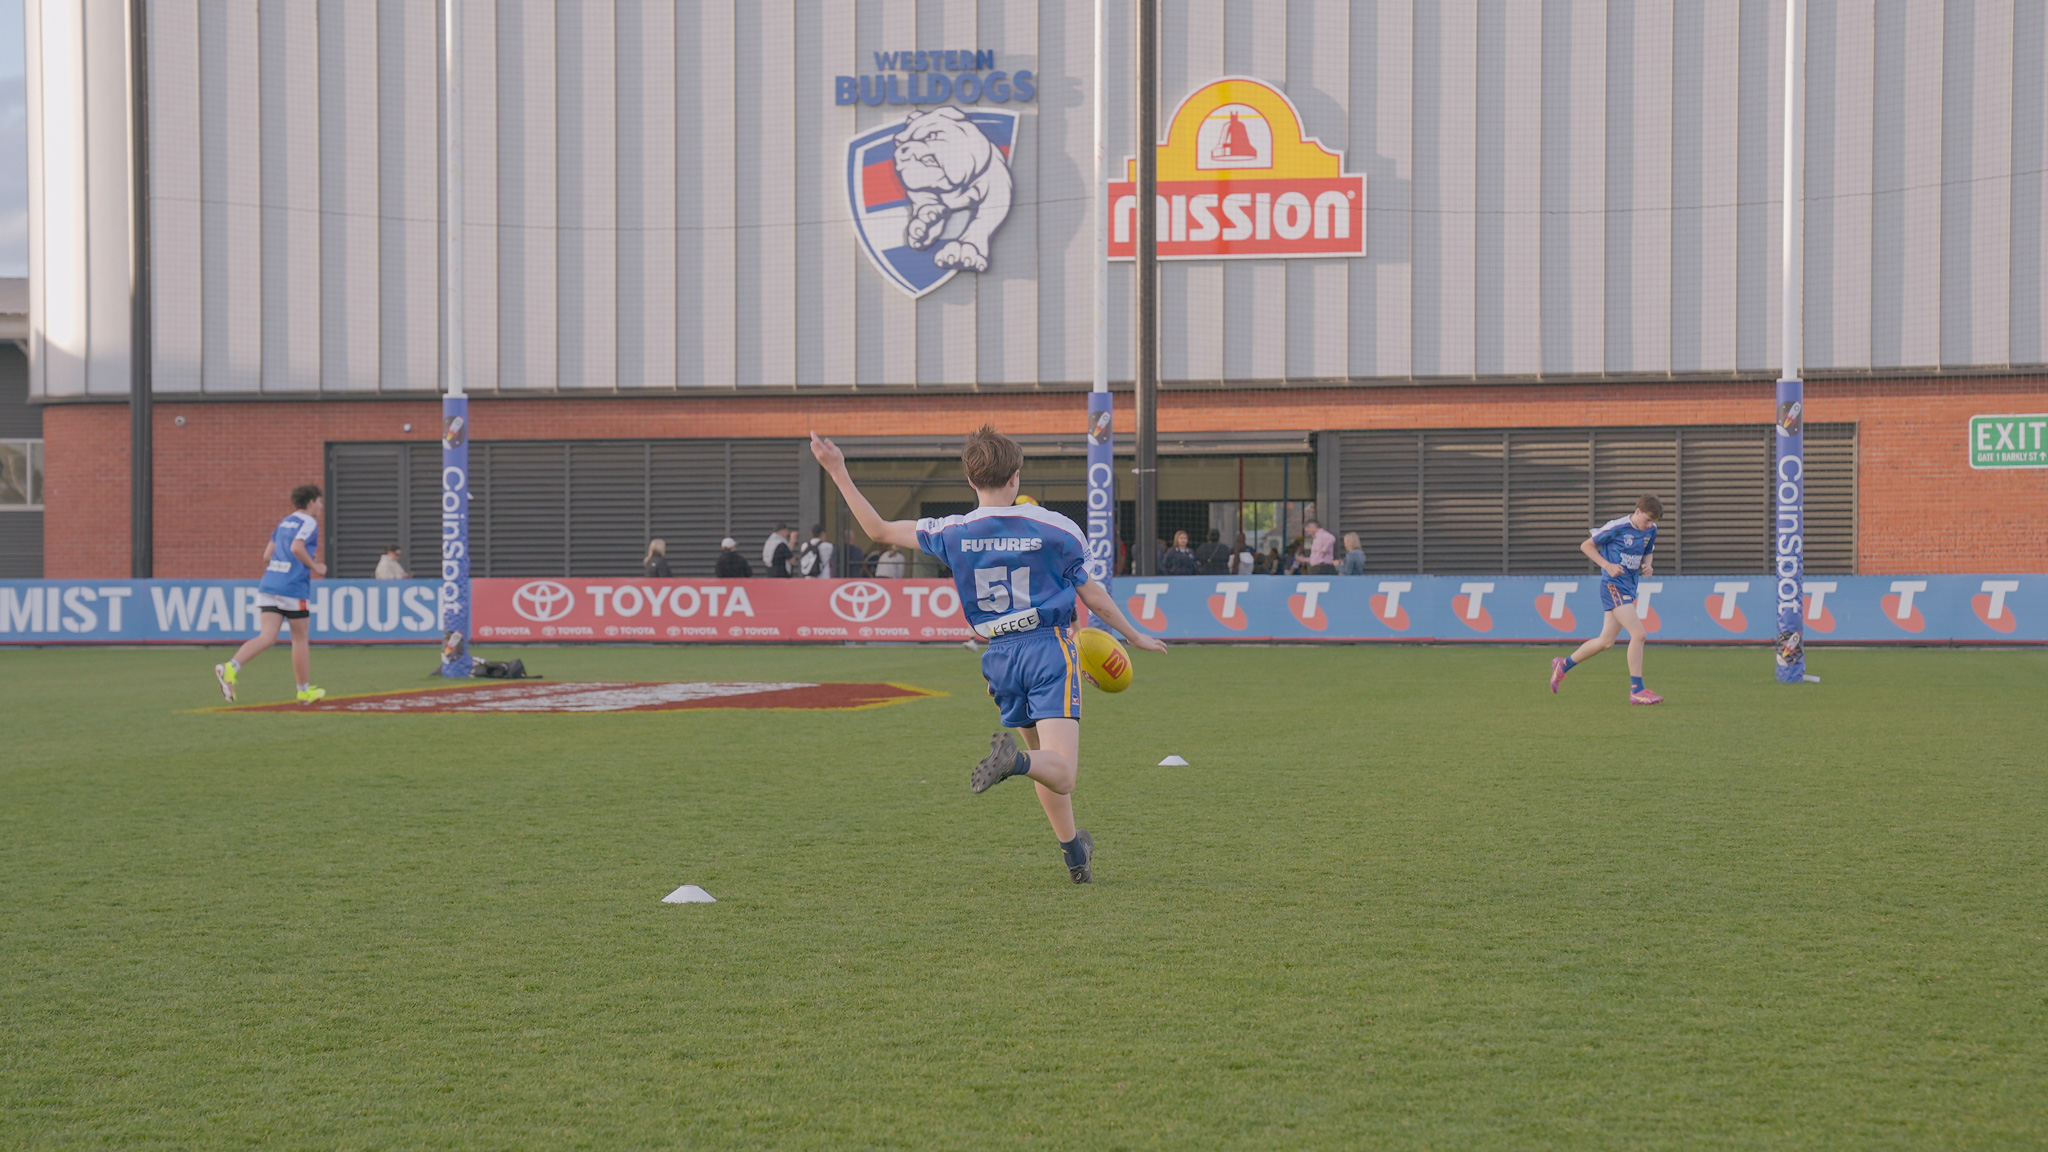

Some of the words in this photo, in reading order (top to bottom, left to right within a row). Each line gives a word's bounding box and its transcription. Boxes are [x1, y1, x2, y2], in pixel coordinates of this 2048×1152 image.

[874, 49, 994, 71] WESTERN
[835, 70, 1035, 106] BULLDOGS
[1114, 190, 1350, 243] MISSION
[1977, 422, 2047, 450] EXIT
[1977, 452, 1994, 462] GATE
[2028, 452, 2038, 462] ST
[442, 465, 466, 615] CoinSpot
[961, 537, 1042, 552] FUTURES
[1088, 462, 1112, 592] CoinSp
[1776, 454, 1803, 614] CoinSpot
[586, 585, 755, 618] TOYOTA
[974, 566, 1031, 613] 51
[1135, 583, 1169, 619] T
[1215, 582, 1249, 618] T
[1296, 582, 1330, 618] T
[1377, 582, 1412, 618] T
[1460, 582, 1495, 619] T
[1543, 582, 1578, 619] T
[1713, 582, 1749, 619] T
[1802, 582, 1837, 619] T
[1890, 581, 1927, 619] T
[1981, 580, 2019, 619] T
[0, 586, 132, 633] MIST
[150, 586, 446, 633] WARHOUS
[495, 627, 531, 636] TOYOTA
[557, 627, 594, 636] TOYOTA
[620, 627, 656, 636] TOYOTA
[682, 627, 718, 636] TOYOTA
[744, 627, 780, 636] TOYOTA
[812, 627, 848, 636] TOYOTA
[875, 627, 910, 636] TOYOTA
